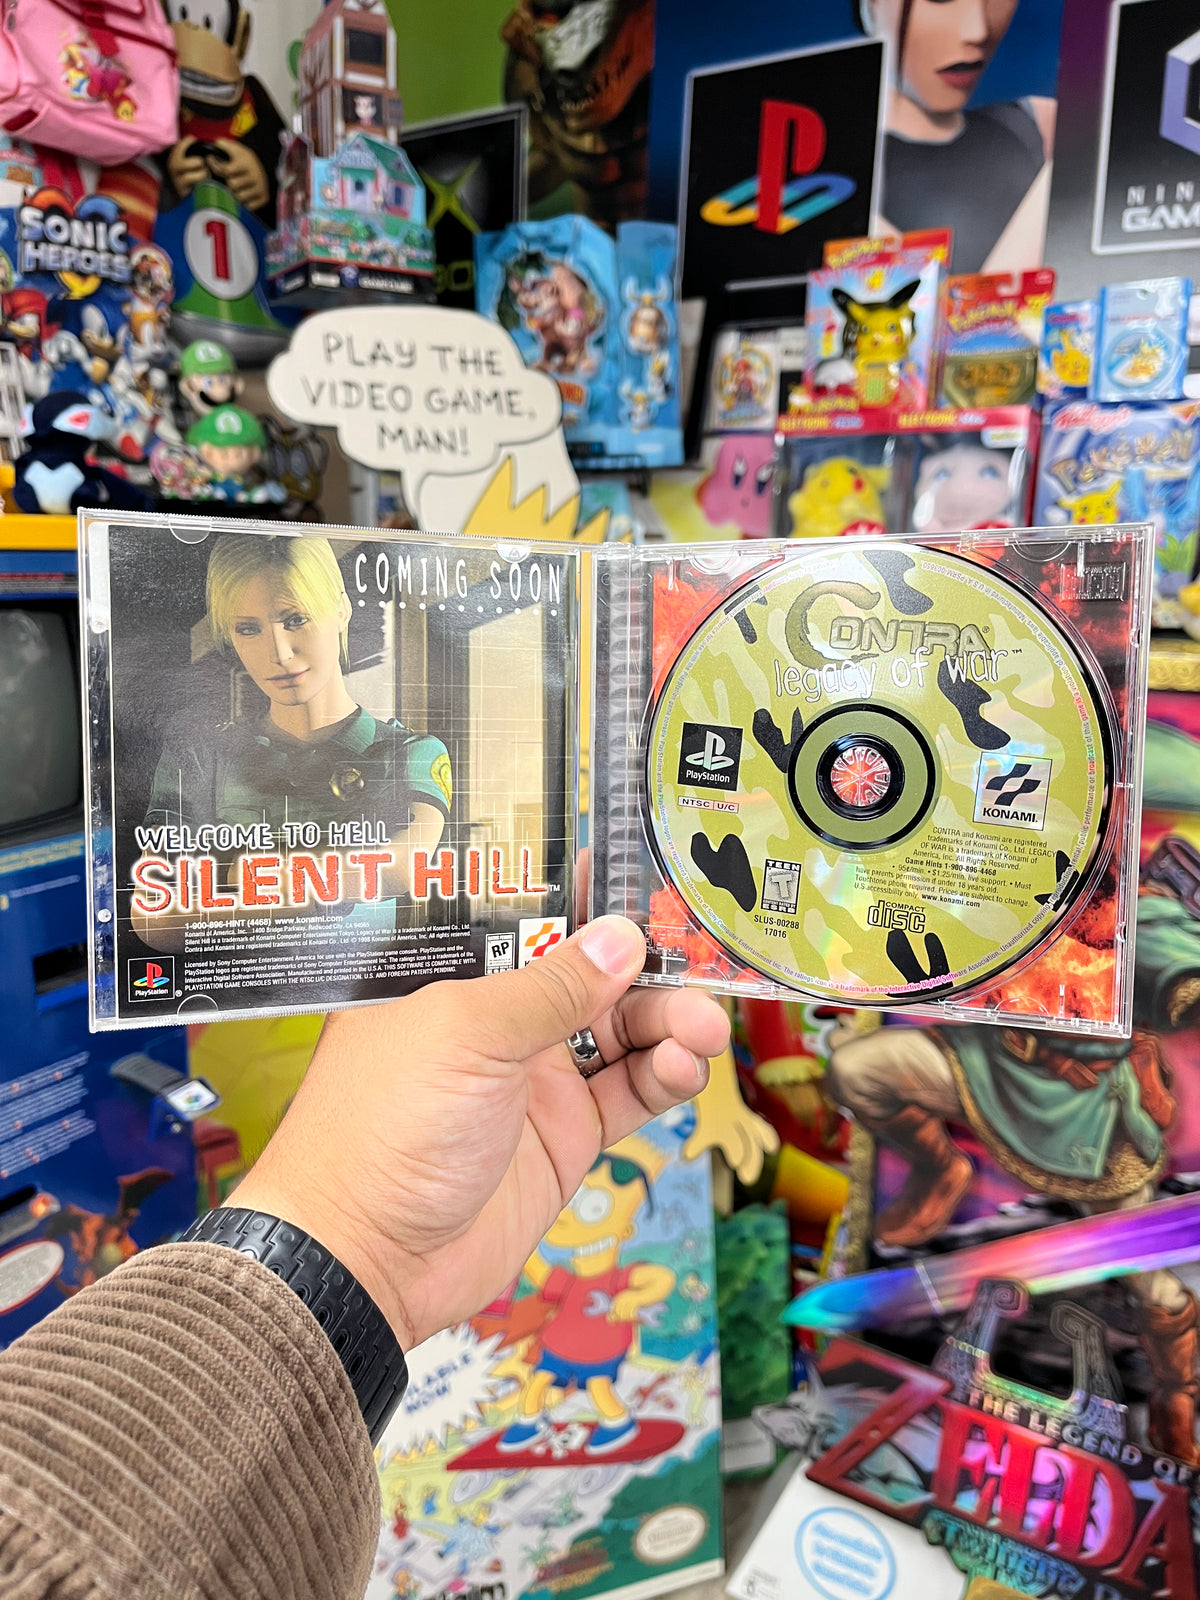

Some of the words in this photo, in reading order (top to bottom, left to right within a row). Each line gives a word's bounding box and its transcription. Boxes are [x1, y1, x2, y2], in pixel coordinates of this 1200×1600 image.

[20, 206, 128, 254] SONIC
[22, 241, 132, 284] HEROES
[205, 220, 231, 281] 1
[323, 331, 417, 369] PLAY
[431, 344, 506, 377] THE
[300, 377, 410, 413] VIDEO
[423, 386, 537, 421] GAME,
[377, 424, 469, 455] MAN!
[355, 552, 467, 599] COMING
[490, 562, 562, 604] SOON
[785, 580, 993, 671] CONTRA
[773, 657, 877, 704] legacy
[891, 646, 932, 688] of
[945, 649, 1008, 684] war
[1086, 743, 1095, 774] broadcast
[685, 769, 731, 784] PlayStation
[682, 798, 710, 808] NTSC
[717, 803, 736, 811] U/C
[1082, 785, 1096, 825] performance
[135, 822, 273, 852] WELCOME
[285, 822, 317, 848] TO
[329, 821, 391, 846] HELL
[927, 834, 963, 845] trademarks
[973, 841, 998, 850] Konami
[1028, 847, 1057, 858] LEGACY
[932, 826, 961, 837] CONTRA
[962, 831, 974, 839] and
[975, 832, 1000, 842] Konami
[1001, 836, 1012, 844] are
[1013, 838, 1048, 848] registered
[931, 843, 947, 852] WAR
[961, 847, 993, 858] trademark
[1003, 853, 1029, 863] Konami
[966, 856, 987, 866] Rights
[767, 860, 801, 872] TEEN
[905, 857, 924, 866] Game
[925, 860, 943, 868] Hints
[944, 863, 997, 876] 1-900-896-4468
[132, 853, 393, 913] SILENT
[413, 849, 548, 899] HILL
[871, 869, 894, 878] parents
[937, 879, 956, 887] under
[967, 884, 984, 892] years
[888, 880, 907, 888] phone
[938, 887, 957, 896] Prices
[971, 892, 995, 902] subject
[1014, 881, 1031, 890] Must
[885, 901, 926, 913] COMPACT
[921, 893, 980, 908] www.konami.com
[185, 919, 246, 930] 1-900-896-HINT
[247, 918, 272, 928] (4468)
[274, 915, 343, 924] www.konami.com
[754, 915, 800, 930] SLUS-00288
[764, 928, 788, 939] 17016
[999, 921, 1033, 952] Unauthorized
[491, 941, 510, 958] RP
[185, 976, 212, 984] Interactive
[397, 961, 424, 969] SOFTWARE
[431, 959, 462, 967] COMPATIBLE
[185, 982, 223, 991] PLAYSTATION
[224, 980, 241, 988] GAME
[242, 978, 271, 987] CONSOLES
[272, 977, 287, 985] WITH
[288, 976, 299, 984] THE
[300, 975, 315, 983] NTSC
[388, 968, 410, 976] FOREIGN
[411, 967, 433, 975] PATENTS
[135, 988, 169, 997] PlayStation
[969, 1388, 1021, 1424] THE
[1029, 1409, 1143, 1466] LEGEND
